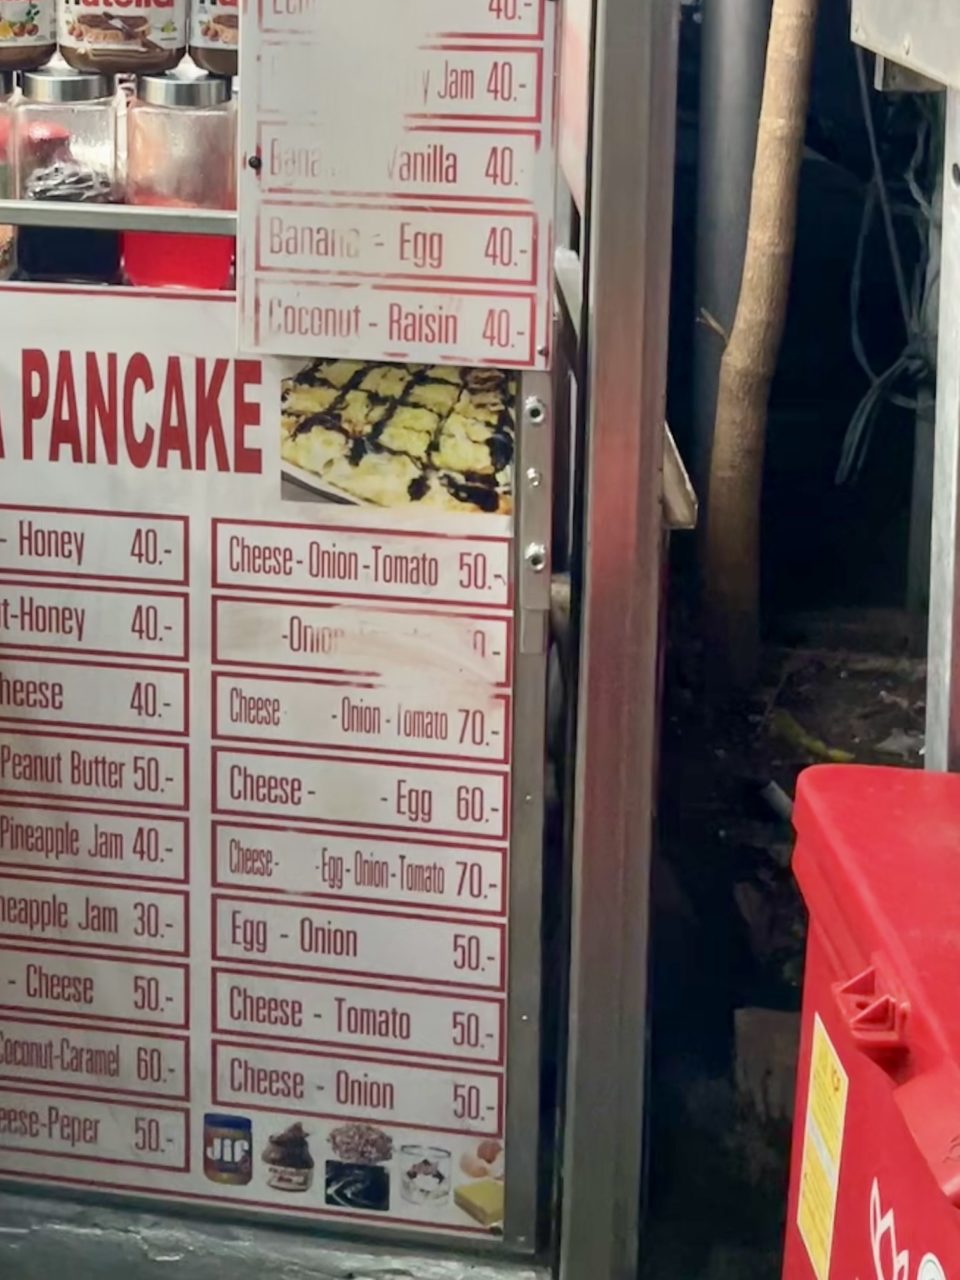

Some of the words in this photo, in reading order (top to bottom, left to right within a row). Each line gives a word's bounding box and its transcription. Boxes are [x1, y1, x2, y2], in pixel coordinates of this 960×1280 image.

[437, 60, 474, 100] Jam
[486, 61, 527, 102] 40.-
[399, 222, 443, 269] Egg
[484, 226, 528, 268] 40.-
[388, 302, 458, 345] Raisin
[482, 308, 525, 349] 40.-
[20, 347, 264, 475] PANCAKE
[18, 520, 86, 566] Honey
[130, 528, 172, 566] 40.-
[229, 535, 293, 576] Cheese
[309, 541, 359, 581] Onion
[459, 553, 503, 591] 50.-
[131, 605, 173, 642] 40.-
[130, 682, 172, 718] 40.-
[230, 687, 280, 727] Cheese
[341, 696, 381, 736] Onion
[458, 708, 500, 747] 70.-
[0, 744, 63, 784] Peanut
[70, 749, 126, 789] Butter
[133, 756, 174, 793] 50.-
[396, 779, 433, 823] Egg
[456, 785, 500, 823] 60.-
[0, 815, 80, 860] Pineapple
[88, 823, 124, 860] Jam
[132, 826, 174, 863] 40.-
[455, 861, 498, 899] 70.-
[78, 897, 118, 934] Jam
[133, 902, 175, 939] 30.-
[231, 910, 268, 954] Egg
[300, 916, 358, 958] Onion
[452, 933, 496, 972] 50.-
[25, 963, 94, 1005] Cheese
[133, 975, 174, 1012] 50.-
[229, 985, 303, 1027] Cheese
[334, 997, 411, 1040] Tomato
[452, 1011, 494, 1048] 50.-
[137, 1047, 176, 1084] 60.-
[229, 1057, 305, 1100] Cheese
[336, 1070, 394, 1110] Onion
[452, 1084, 496, 1121] 50.-
[134, 1116, 174, 1153] 50.-
